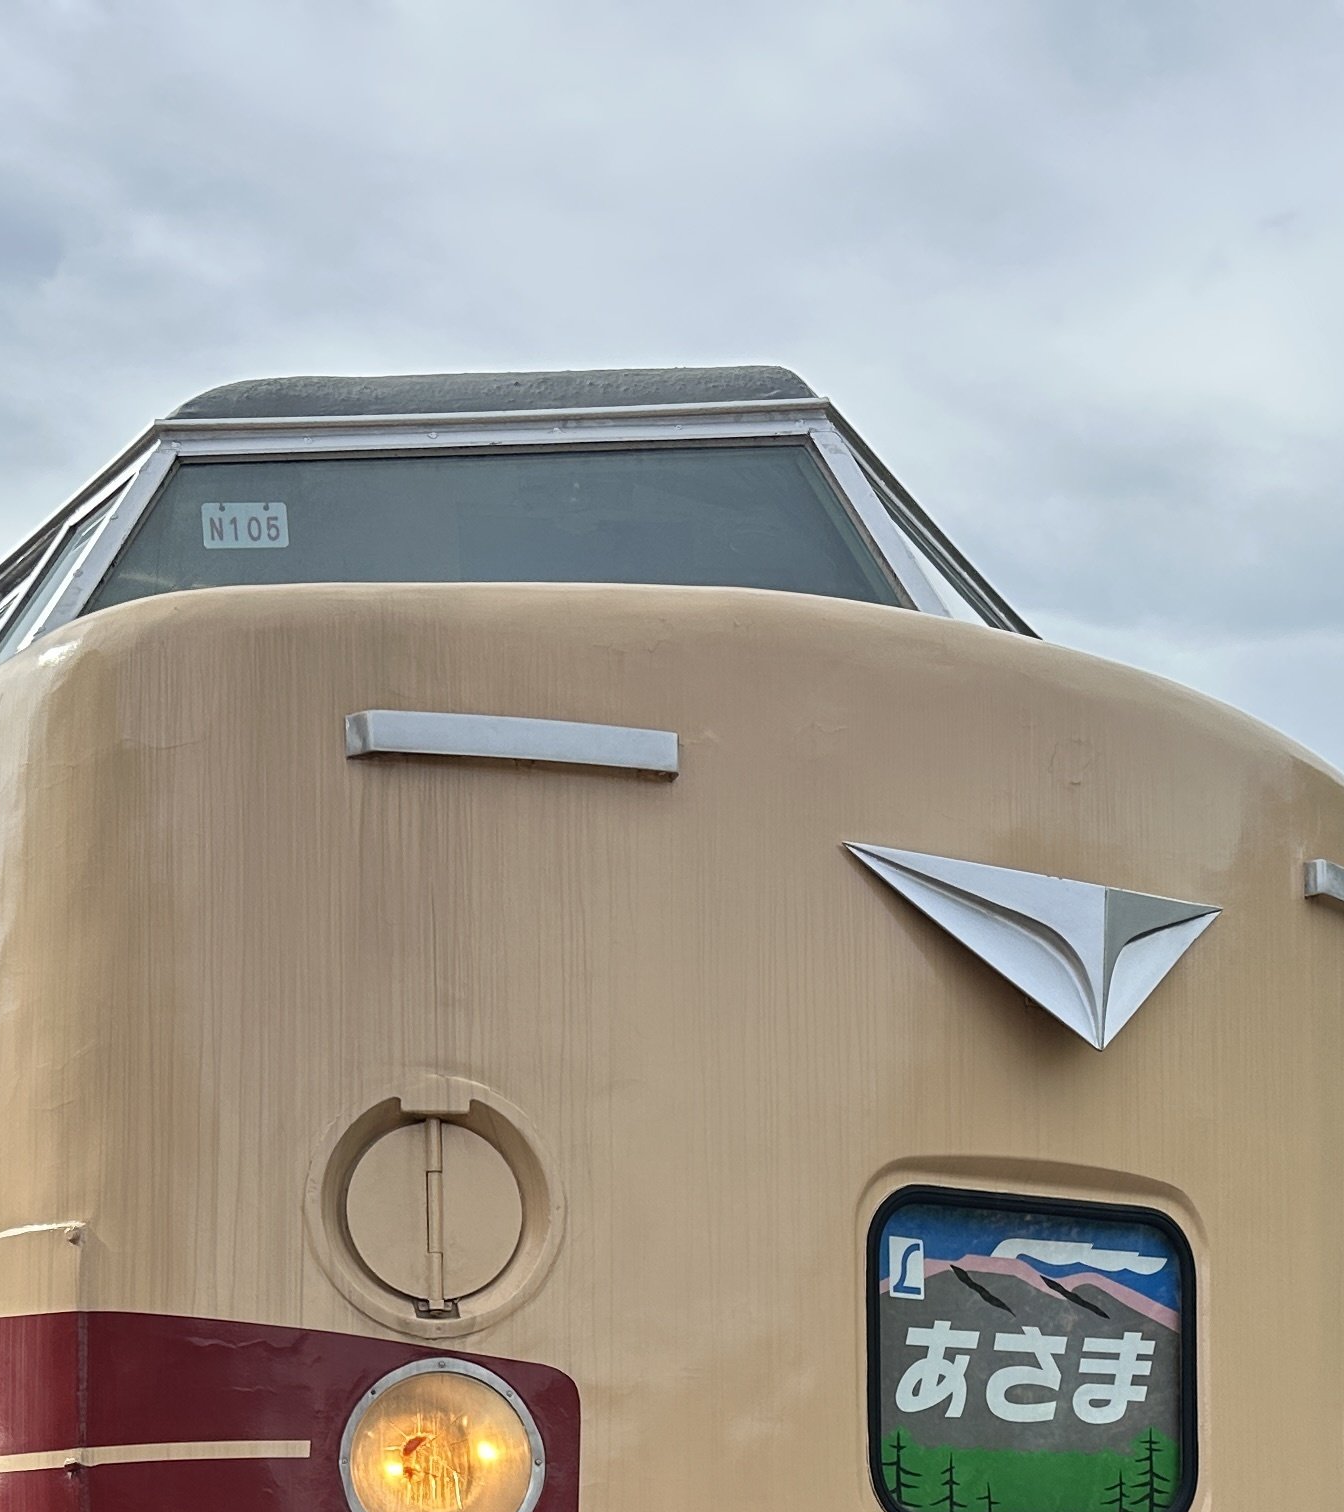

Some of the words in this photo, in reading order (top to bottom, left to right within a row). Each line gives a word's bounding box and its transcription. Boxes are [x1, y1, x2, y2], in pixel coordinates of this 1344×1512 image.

[209, 516, 280, 542] N105
[894, 1319, 1157, 1425] あさま
